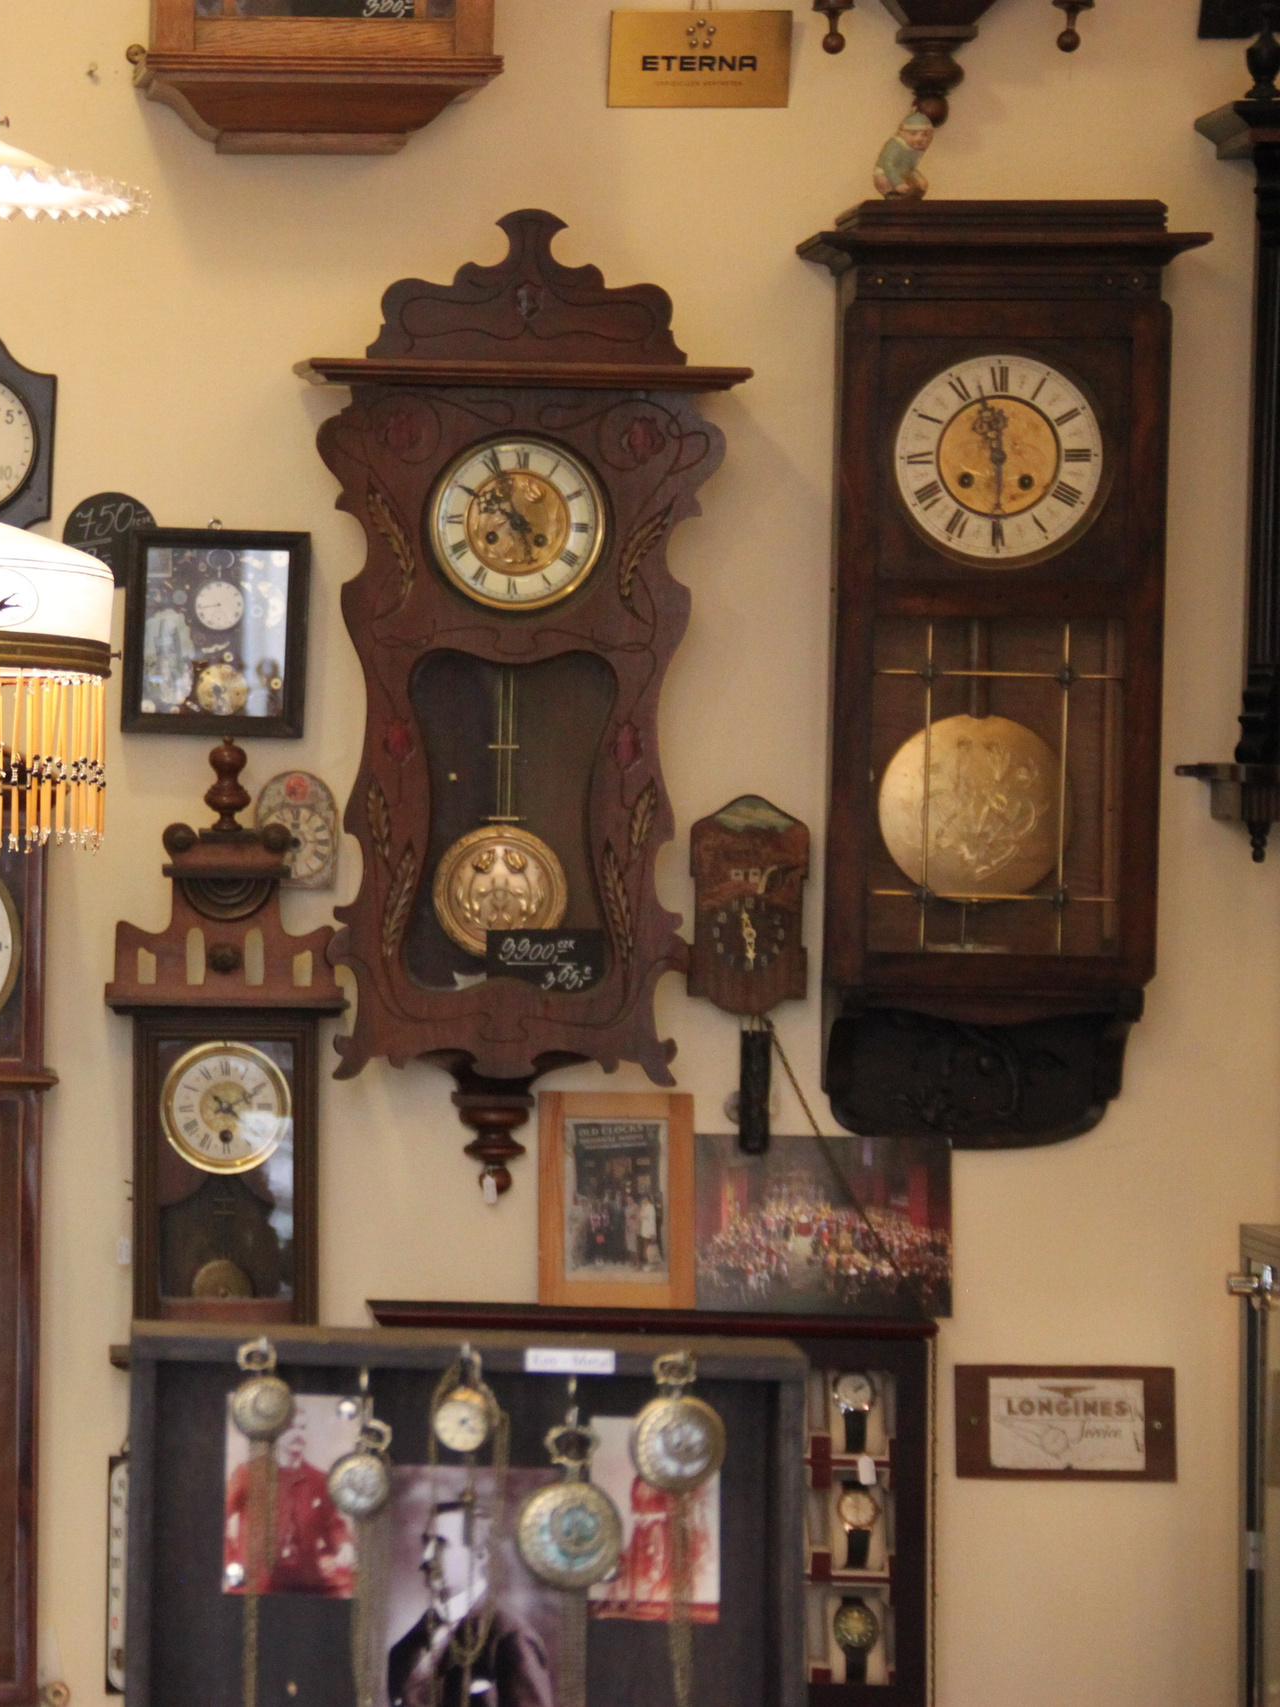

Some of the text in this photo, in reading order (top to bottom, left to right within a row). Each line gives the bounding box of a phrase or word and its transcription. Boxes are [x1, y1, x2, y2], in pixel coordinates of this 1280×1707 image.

[642, 55, 758, 71] ETERNA
[5, 410, 14, 424] 5
[1007, 1398, 1129, 1417] LONGINES
